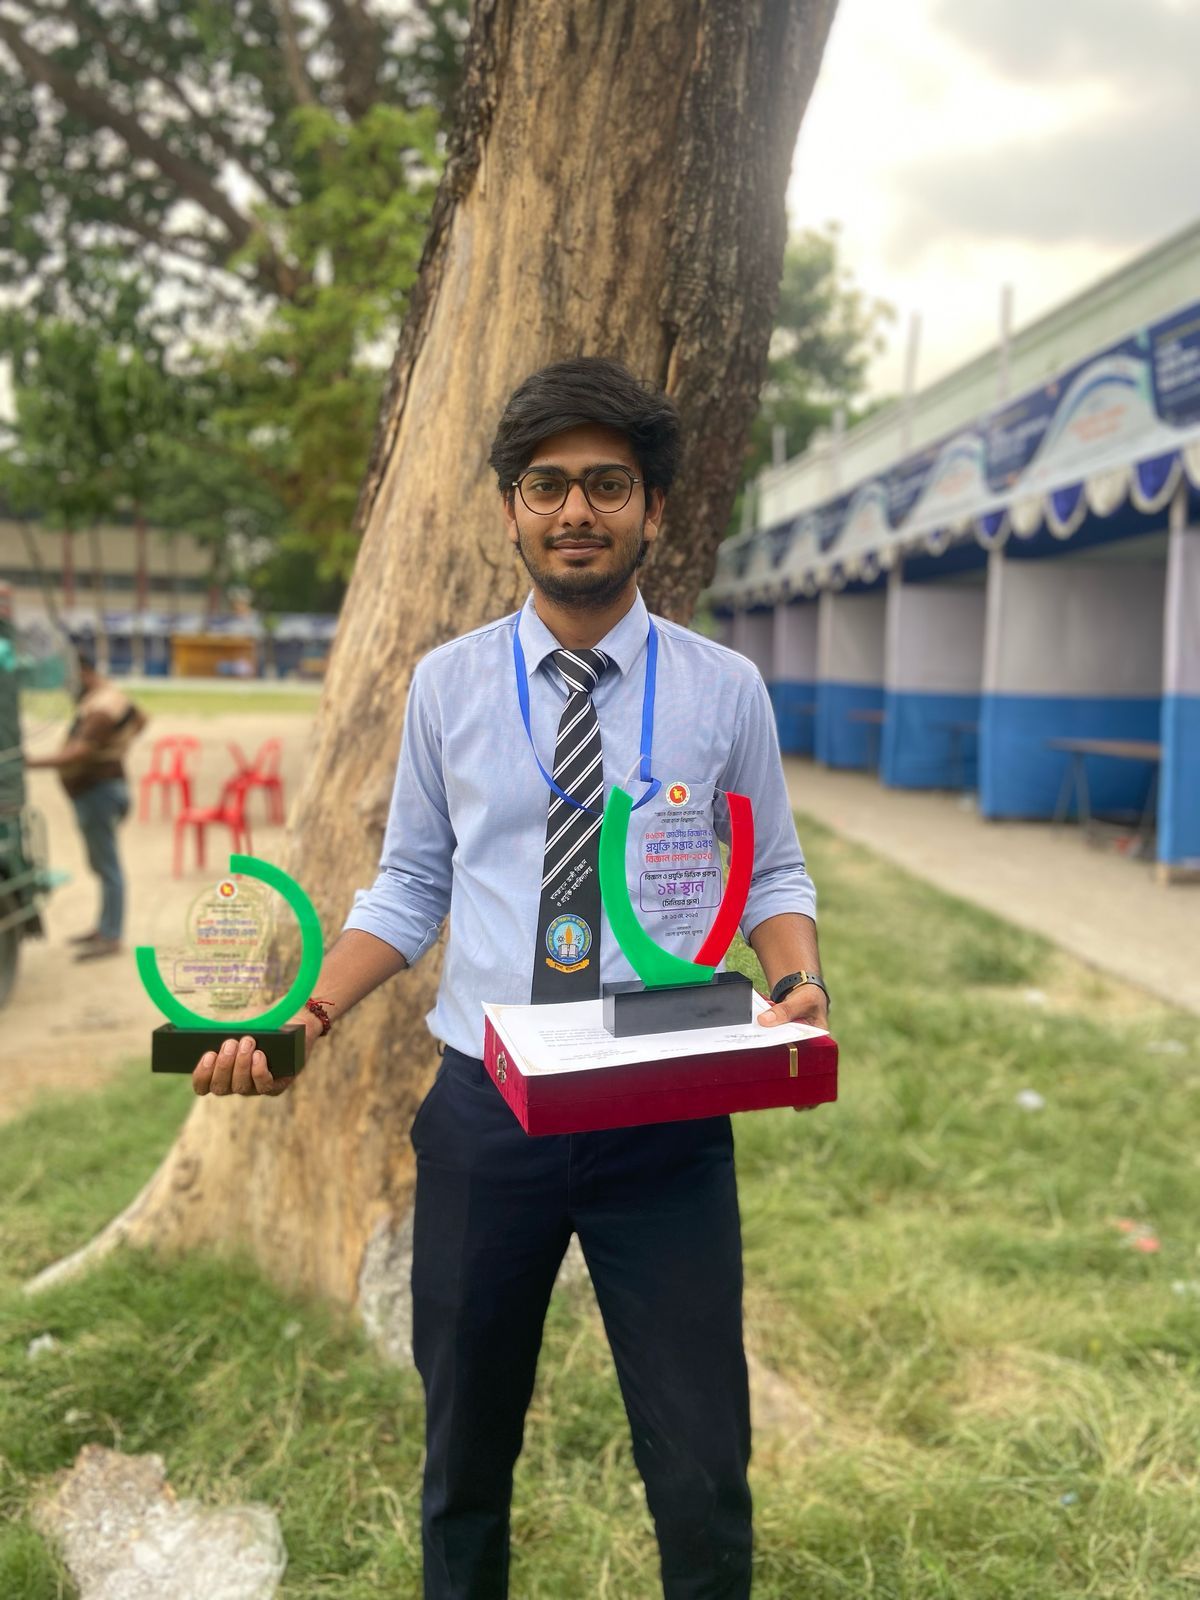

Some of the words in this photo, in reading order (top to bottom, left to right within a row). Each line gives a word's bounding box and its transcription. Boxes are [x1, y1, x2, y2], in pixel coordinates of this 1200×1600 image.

[687, 828, 707, 838] বিজ্ঞান
[646, 840, 671, 854] প্রযুক্তি
[672, 840, 694, 851] সপ্তাহ
[695, 839, 713, 849] এবং
[646, 853, 670, 863] বিজ্ঞান
[644, 873, 662, 881] বিজ্ঞান
[668, 871, 684, 880] প্রযুক্তি
[657, 882, 677, 896] ১ম
[679, 880, 705, 896] স্থান
